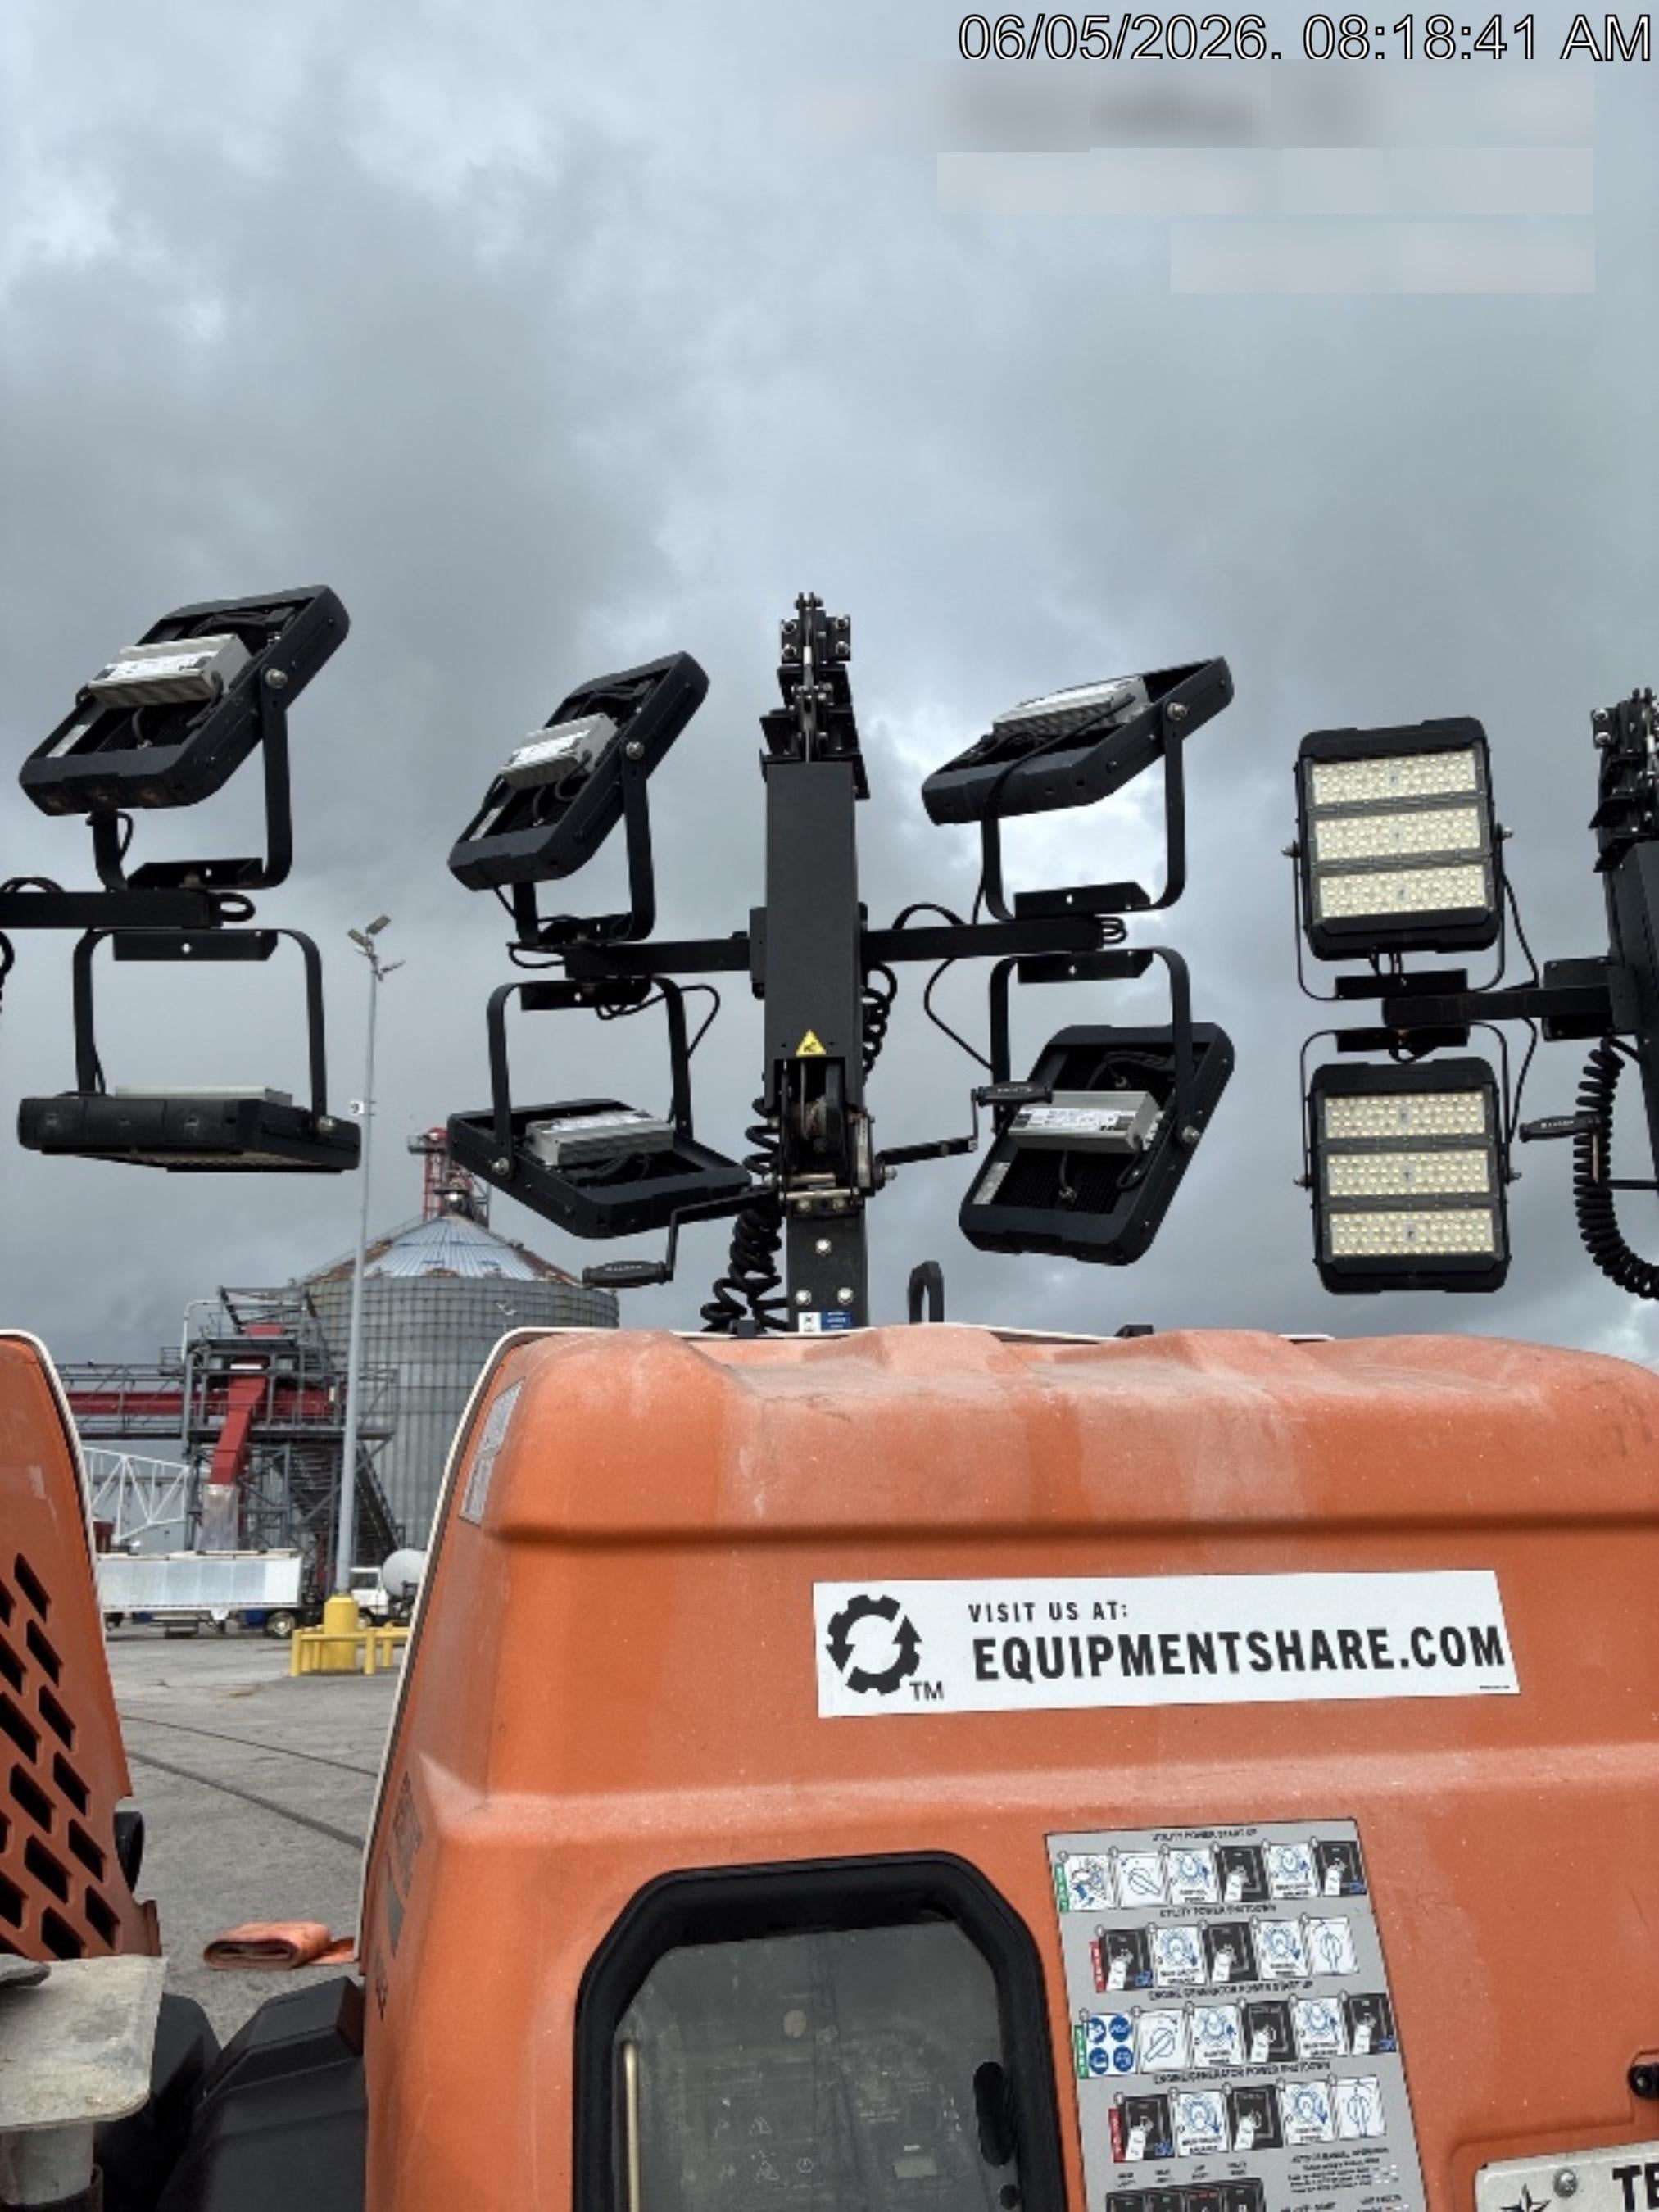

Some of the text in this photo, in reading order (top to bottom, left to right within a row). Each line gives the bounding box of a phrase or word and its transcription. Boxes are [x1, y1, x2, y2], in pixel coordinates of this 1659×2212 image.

[968, 1601, 1127, 1622] VISIT US AT:
[972, 1626, 1506, 1683] EQUIPMENTSHARE.COM
[910, 1681, 944, 1702] TM
